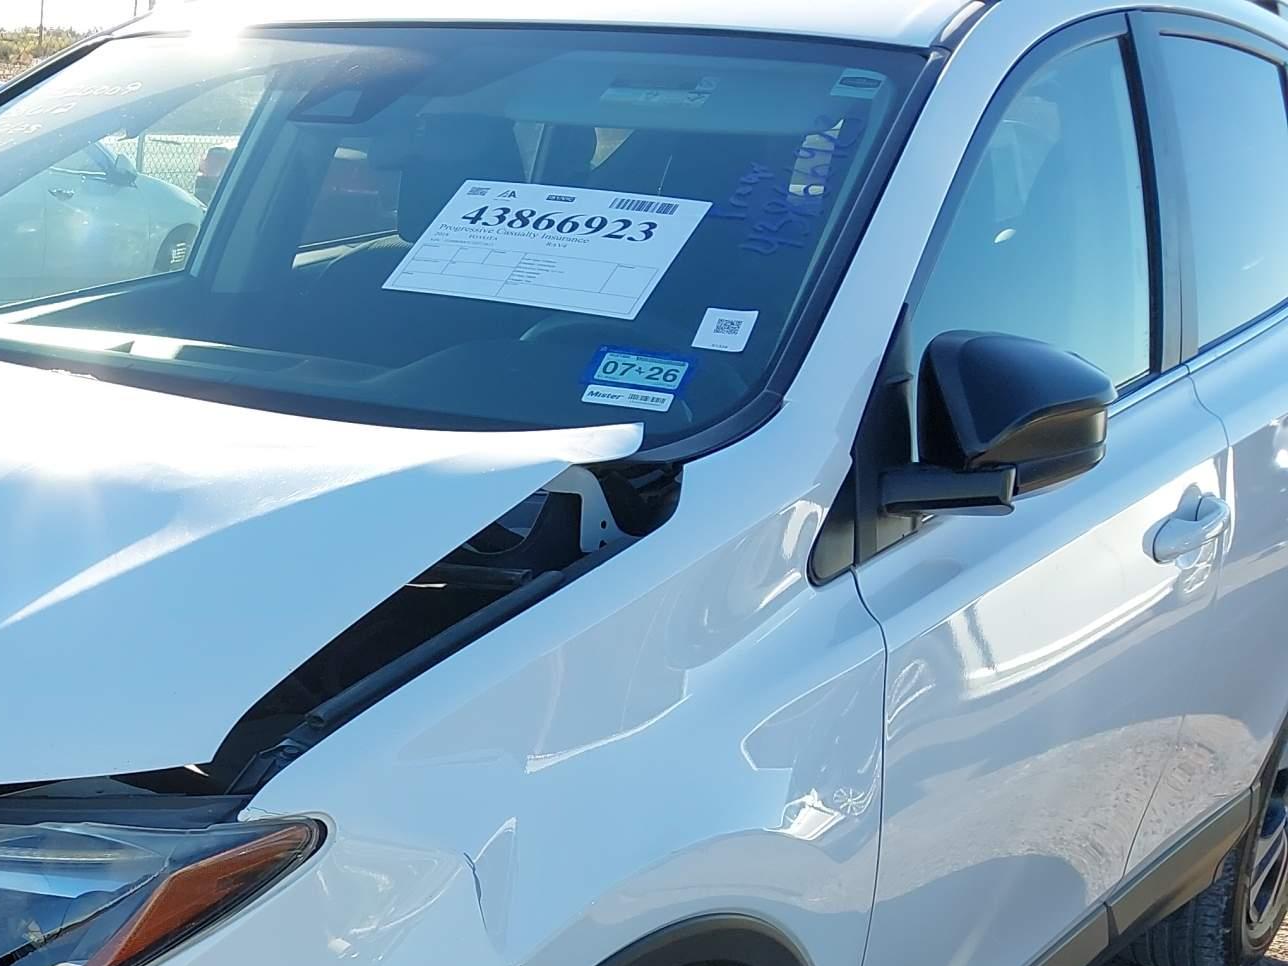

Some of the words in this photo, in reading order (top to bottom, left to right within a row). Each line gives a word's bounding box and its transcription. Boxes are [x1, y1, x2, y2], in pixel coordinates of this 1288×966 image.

[439, 222, 494, 235] Progressive
[497, 228, 537, 240] Casualty
[540, 231, 590, 245] Insurance
[461, 204, 658, 242] 43866923
[602, 360, 637, 376] 07
[644, 366, 681, 383] 26
